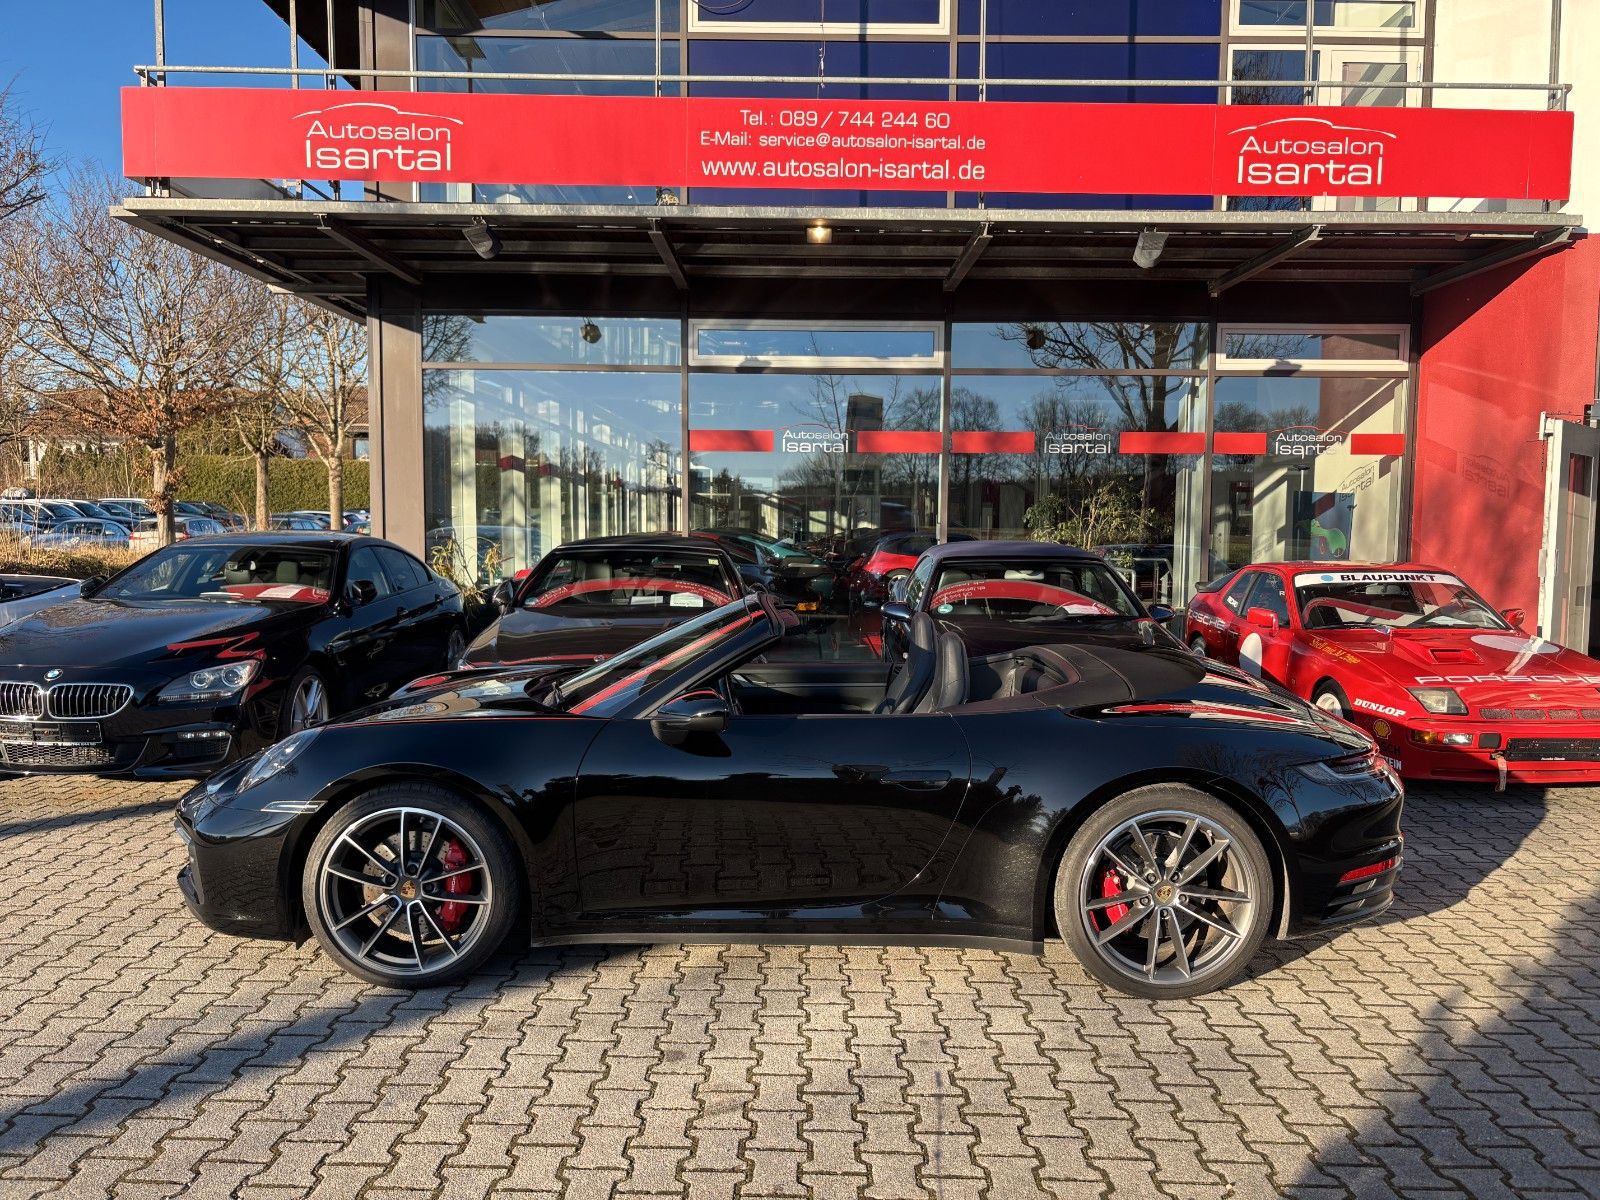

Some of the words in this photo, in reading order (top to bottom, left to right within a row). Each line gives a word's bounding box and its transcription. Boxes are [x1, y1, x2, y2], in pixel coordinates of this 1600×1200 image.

[740, 110, 774, 126] Tel.:
[780, 110, 818, 127] 089
[820, 111, 833, 129] /
[838, 111, 874, 127] 744
[881, 112, 918, 128] 244
[925, 112, 950, 129] 60
[306, 120, 451, 142] Autosalon
[700, 131, 752, 147] E-Mail:
[759, 132, 986, 150] service@autosalon-isartal.de
[1240, 135, 1384, 155] Autosalon
[305, 139, 451, 171] Isartal
[701, 157, 985, 180] www.autosalon-isartal.de
[1237, 155, 1383, 185] Isartal
[783, 429, 849, 440] Autosalon
[1045, 431, 1111, 441] Autosalon
[1276, 432, 1342, 442] Autosalon
[782, 438, 849, 453] Isartal
[1043, 440, 1111, 454] Isartal
[1275, 441, 1342, 456] Isart
[1340, 574, 1436, 582] BLAUPUNKT
[1415, 674, 1600, 685] PORSCHE
[1353, 698, 1407, 717] DUNLOP
